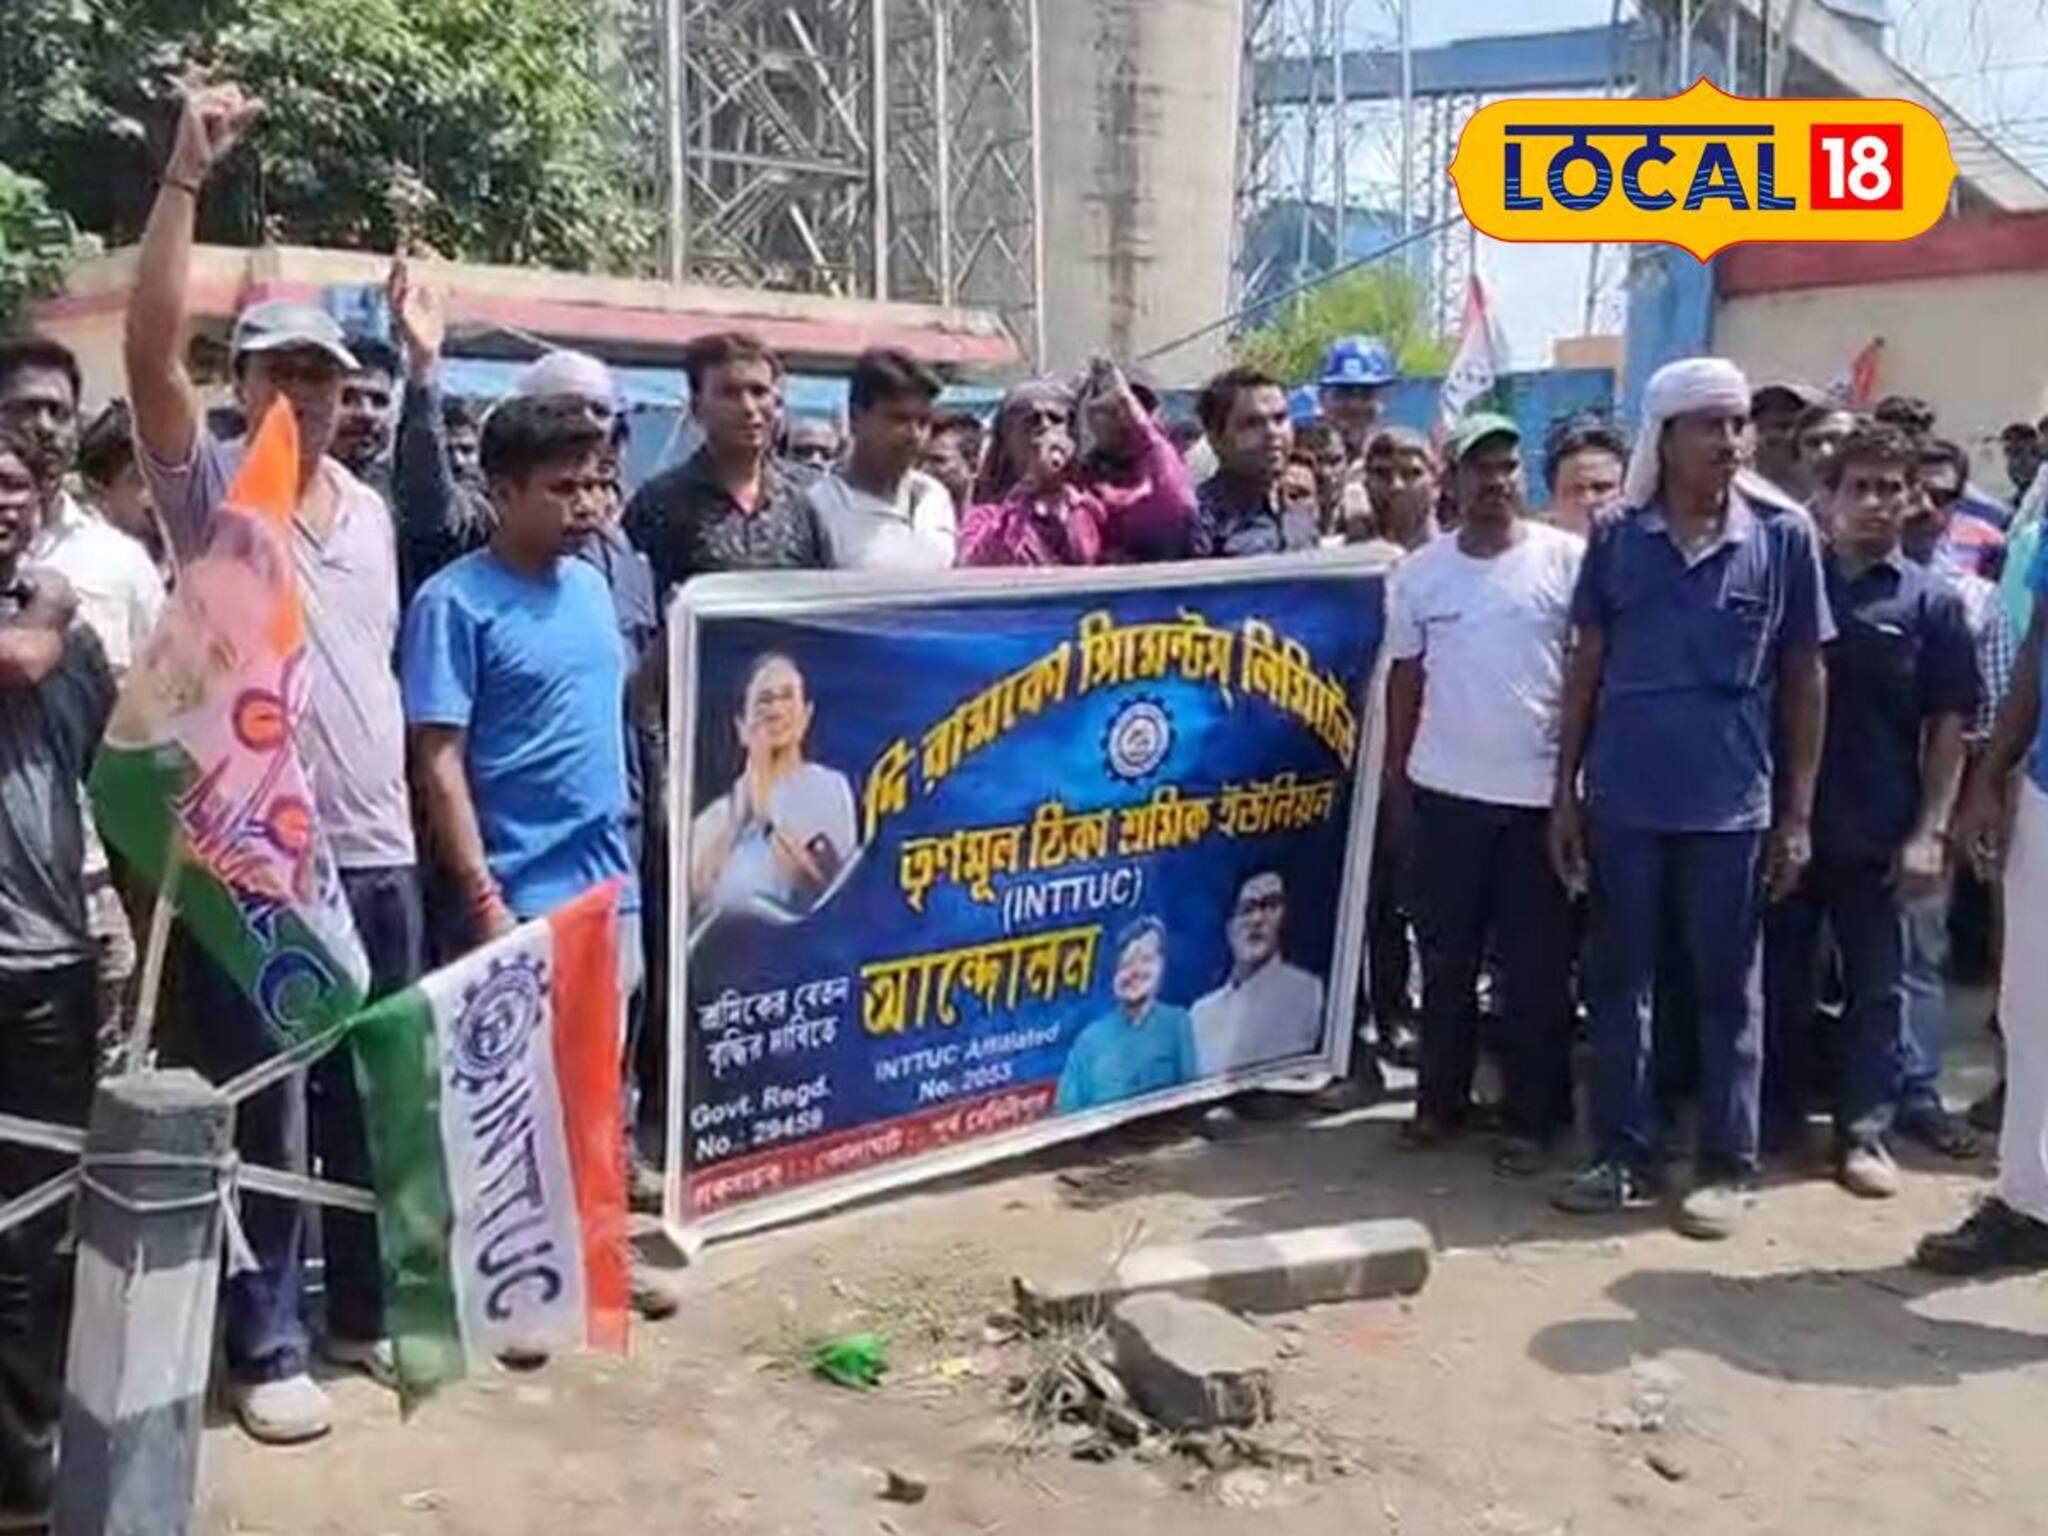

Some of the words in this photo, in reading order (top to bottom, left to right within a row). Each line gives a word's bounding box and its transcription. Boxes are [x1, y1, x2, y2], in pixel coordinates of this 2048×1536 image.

[901, 827, 1024, 913] তৃণমূল
[1030, 801, 1109, 868] ঠিকা
[1118, 784, 1211, 856] শ্রমিক
[1003, 868, 1143, 932] (INTTUC)
[860, 924, 1103, 1034] আন্দোলন
[690, 1096, 754, 1131] Govt.
[762, 1074, 830, 1112] Regd.
[875, 1045, 960, 1082] INTTUC
[470, 1076, 562, 1321] INTTUC
